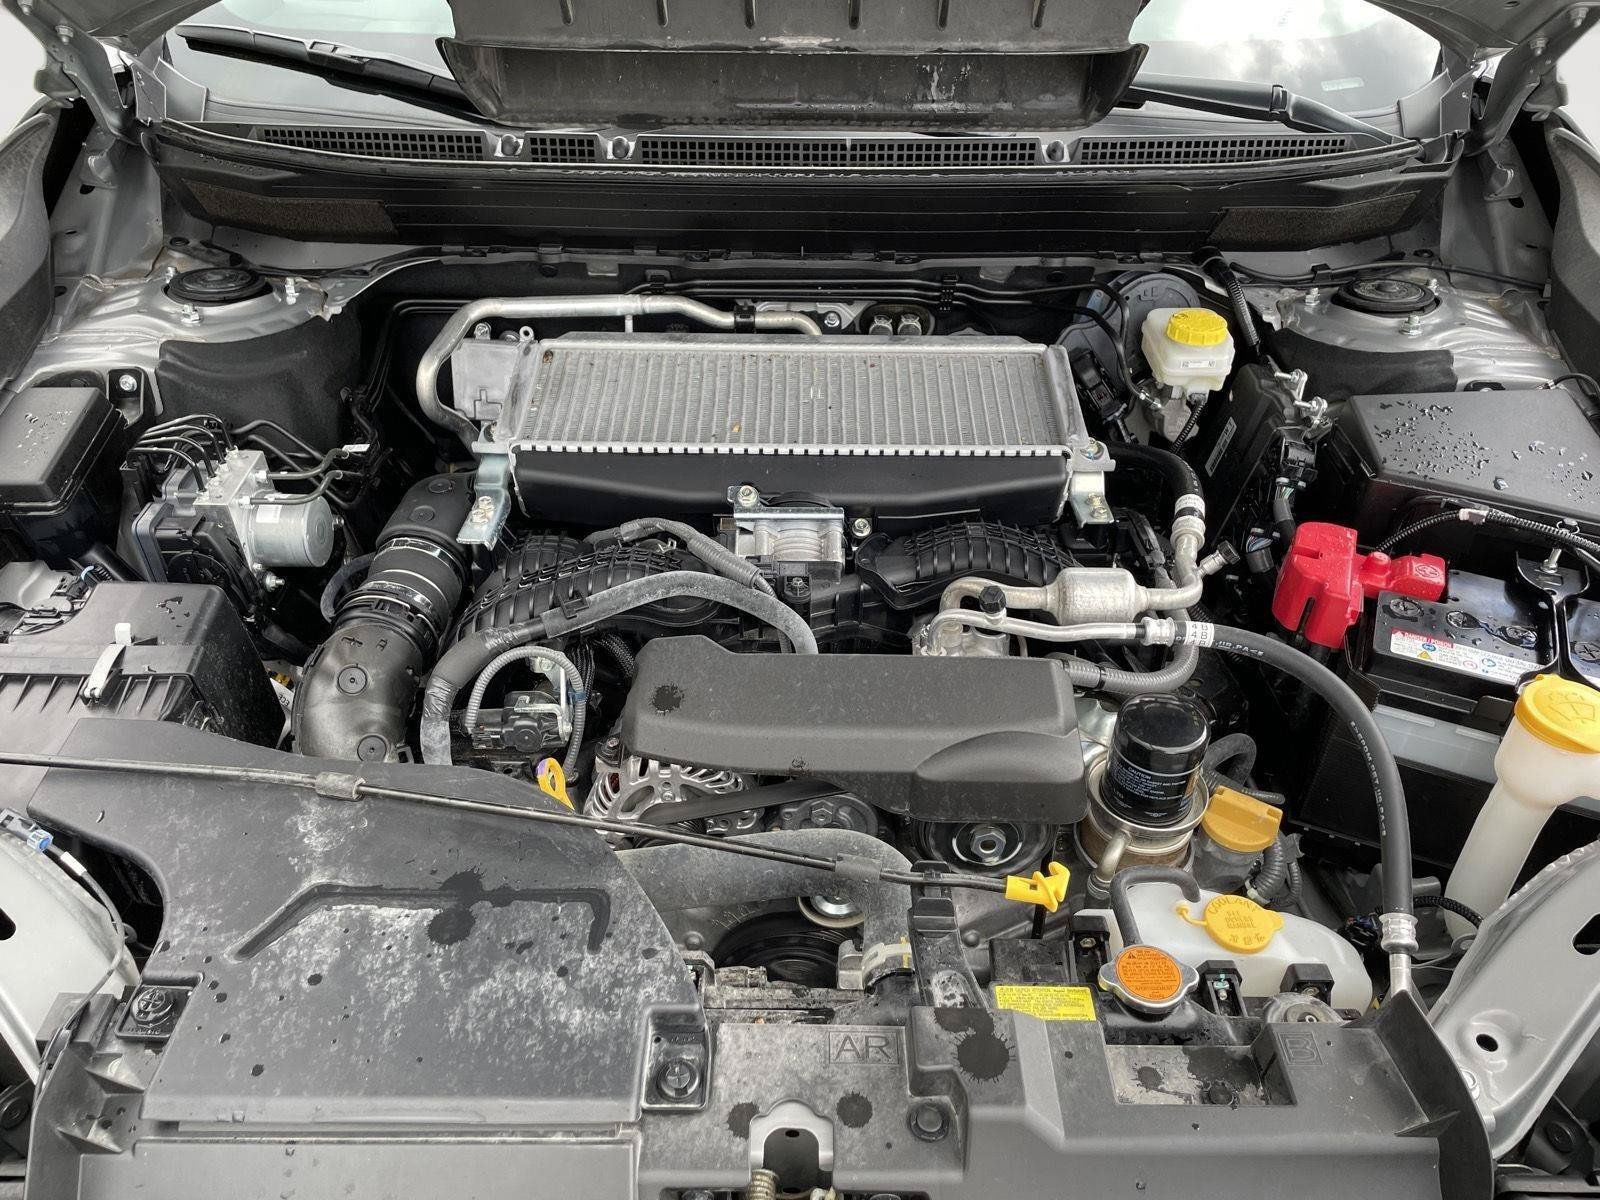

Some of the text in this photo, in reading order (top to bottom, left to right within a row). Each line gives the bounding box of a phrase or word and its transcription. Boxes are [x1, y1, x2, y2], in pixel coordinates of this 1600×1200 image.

[1127, 767, 1152, 780] CAUTION
[834, 1034, 892, 1061] AR
[1284, 1037, 1317, 1062] B
